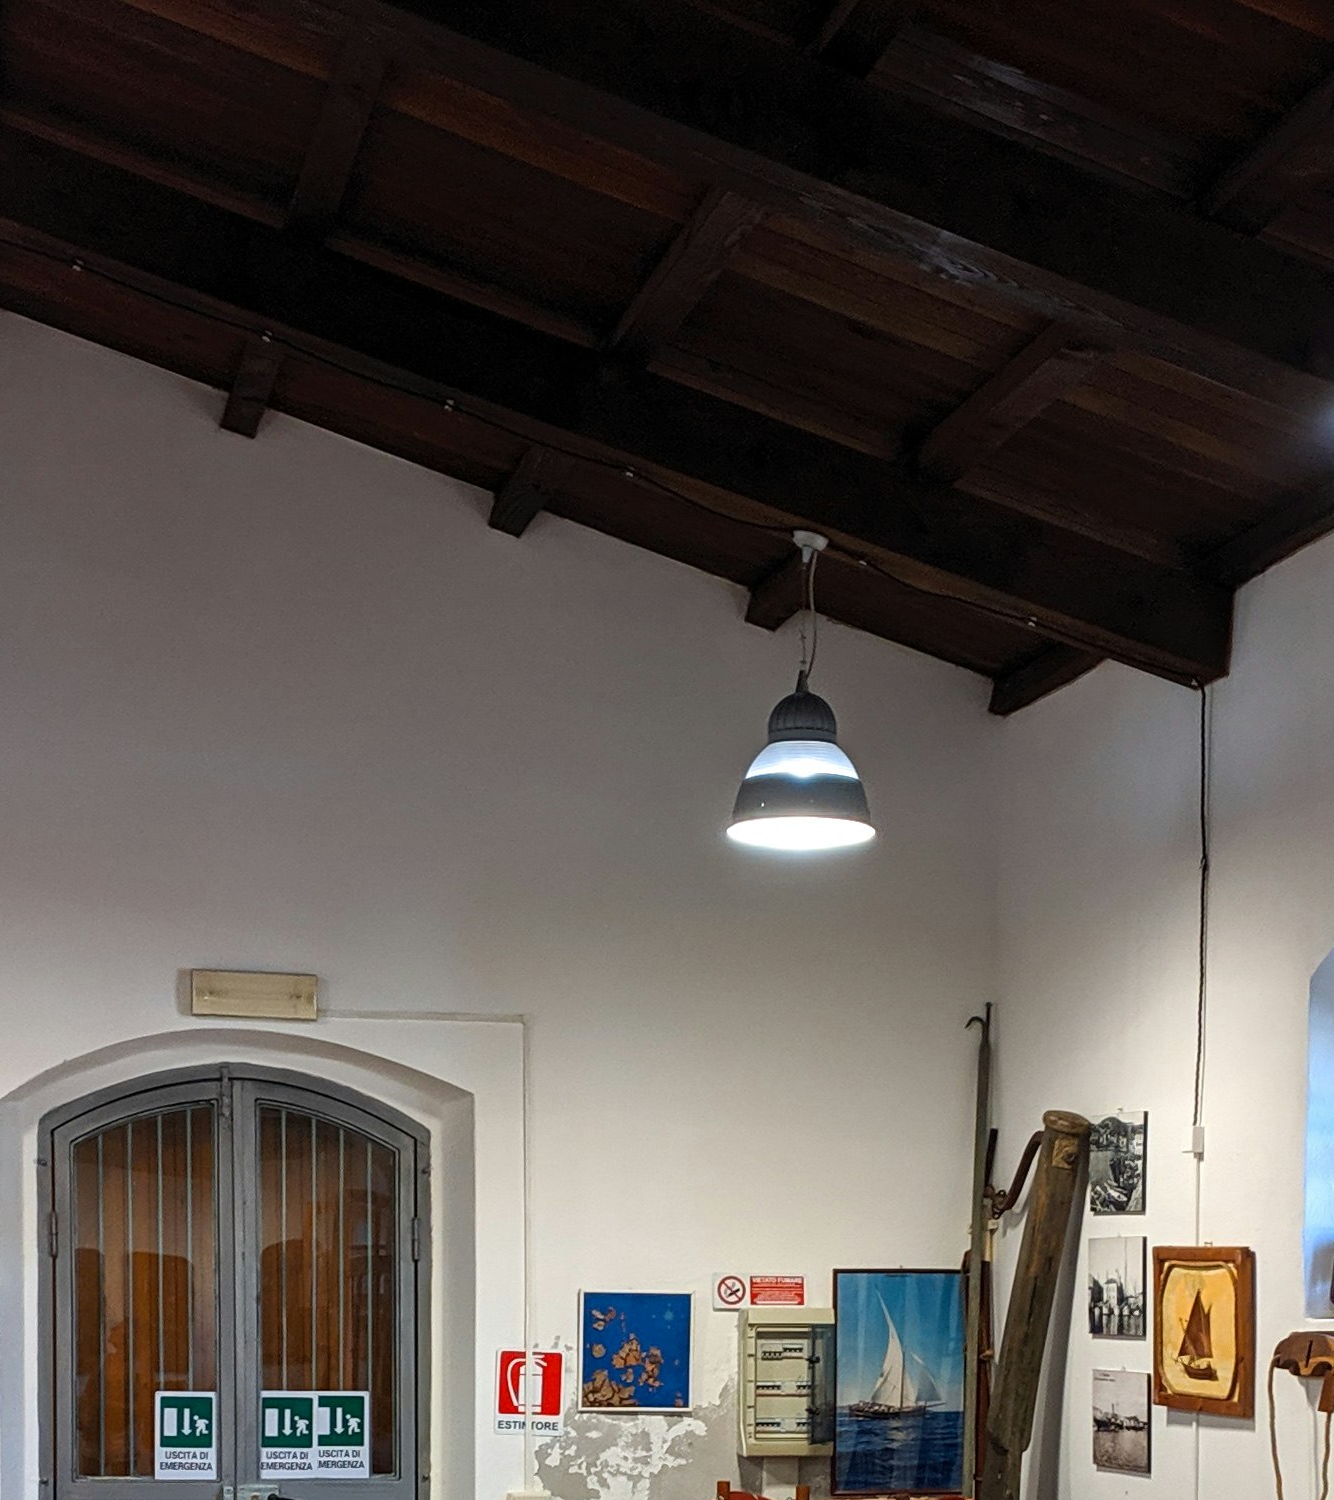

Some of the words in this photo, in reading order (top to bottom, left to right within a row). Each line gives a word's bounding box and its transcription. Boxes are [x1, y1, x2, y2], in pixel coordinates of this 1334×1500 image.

[165, 1451, 198, 1460] USCITA
[199, 1451, 209, 1460] DI
[266, 1451, 298, 1460] USCITA
[300, 1451, 309, 1460] DI
[318, 1449, 350, 1458] USCITA
[352, 1449, 361, 1458] DI
[160, 1462, 213, 1471] EMERGENZA
[260, 1462, 313, 1471] EMERGENZA
[317, 1460, 365, 1469] MERGENZA
